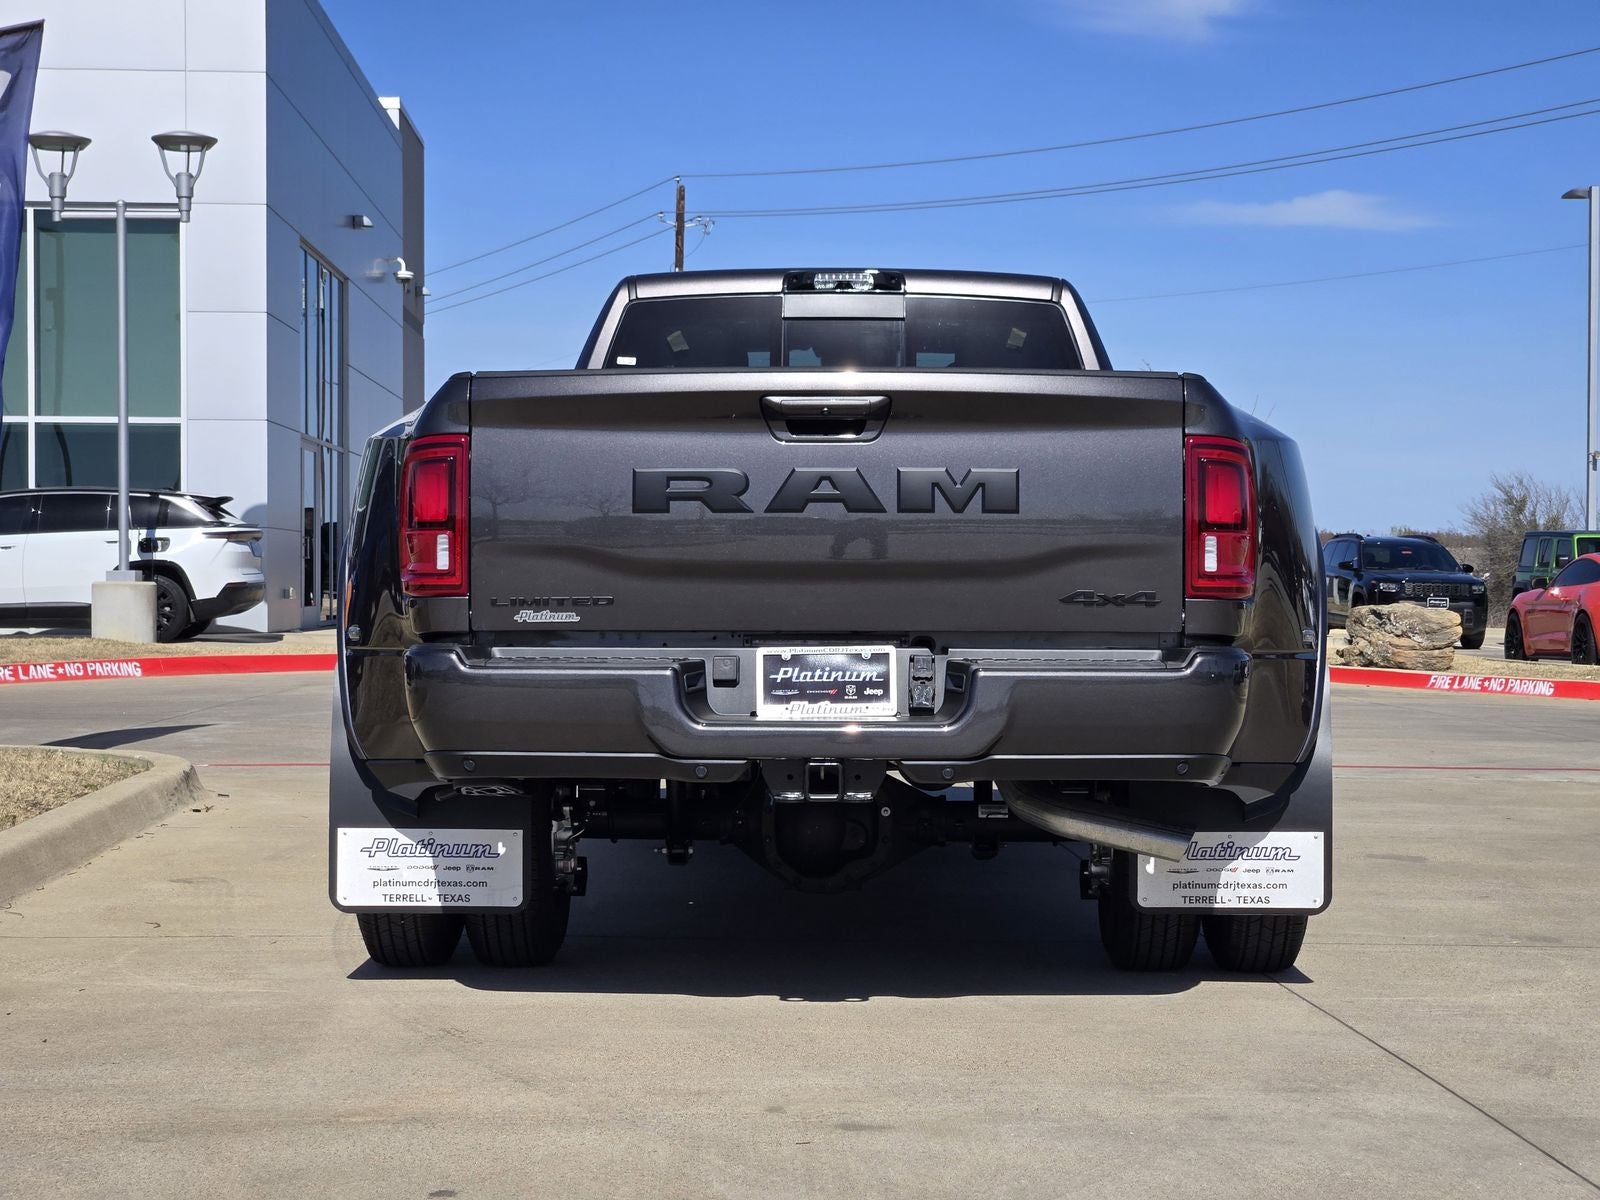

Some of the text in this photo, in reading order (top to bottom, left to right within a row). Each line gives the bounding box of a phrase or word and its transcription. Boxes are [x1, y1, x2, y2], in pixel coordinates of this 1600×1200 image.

[632, 467, 1020, 514] RAM
[491, 596, 614, 607] LIMITED
[1058, 590, 1160, 608] 4x4
[514, 610, 580, 622] Platinum
[18, 664, 57, 680] LANE
[64, 663, 84, 676] NO
[87, 662, 142, 677] PARKING
[769, 667, 884, 682] Platinum
[1427, 675, 1555, 696] FIRE LANE NO PARKING
[863, 688, 884, 696] Jeep
[789, 703, 867, 715] Platinum
[360, 838, 501, 858] Platinum
[1184, 840, 1301, 861] latinum
[372, 878, 488, 889] platinumcdrjtexas.com
[1172, 881, 1288, 892] platinumcdrjtexas.com
[382, 893, 471, 903] TERRELL TEXAS
[1181, 896, 1270, 905] TERRELL TEXAS
